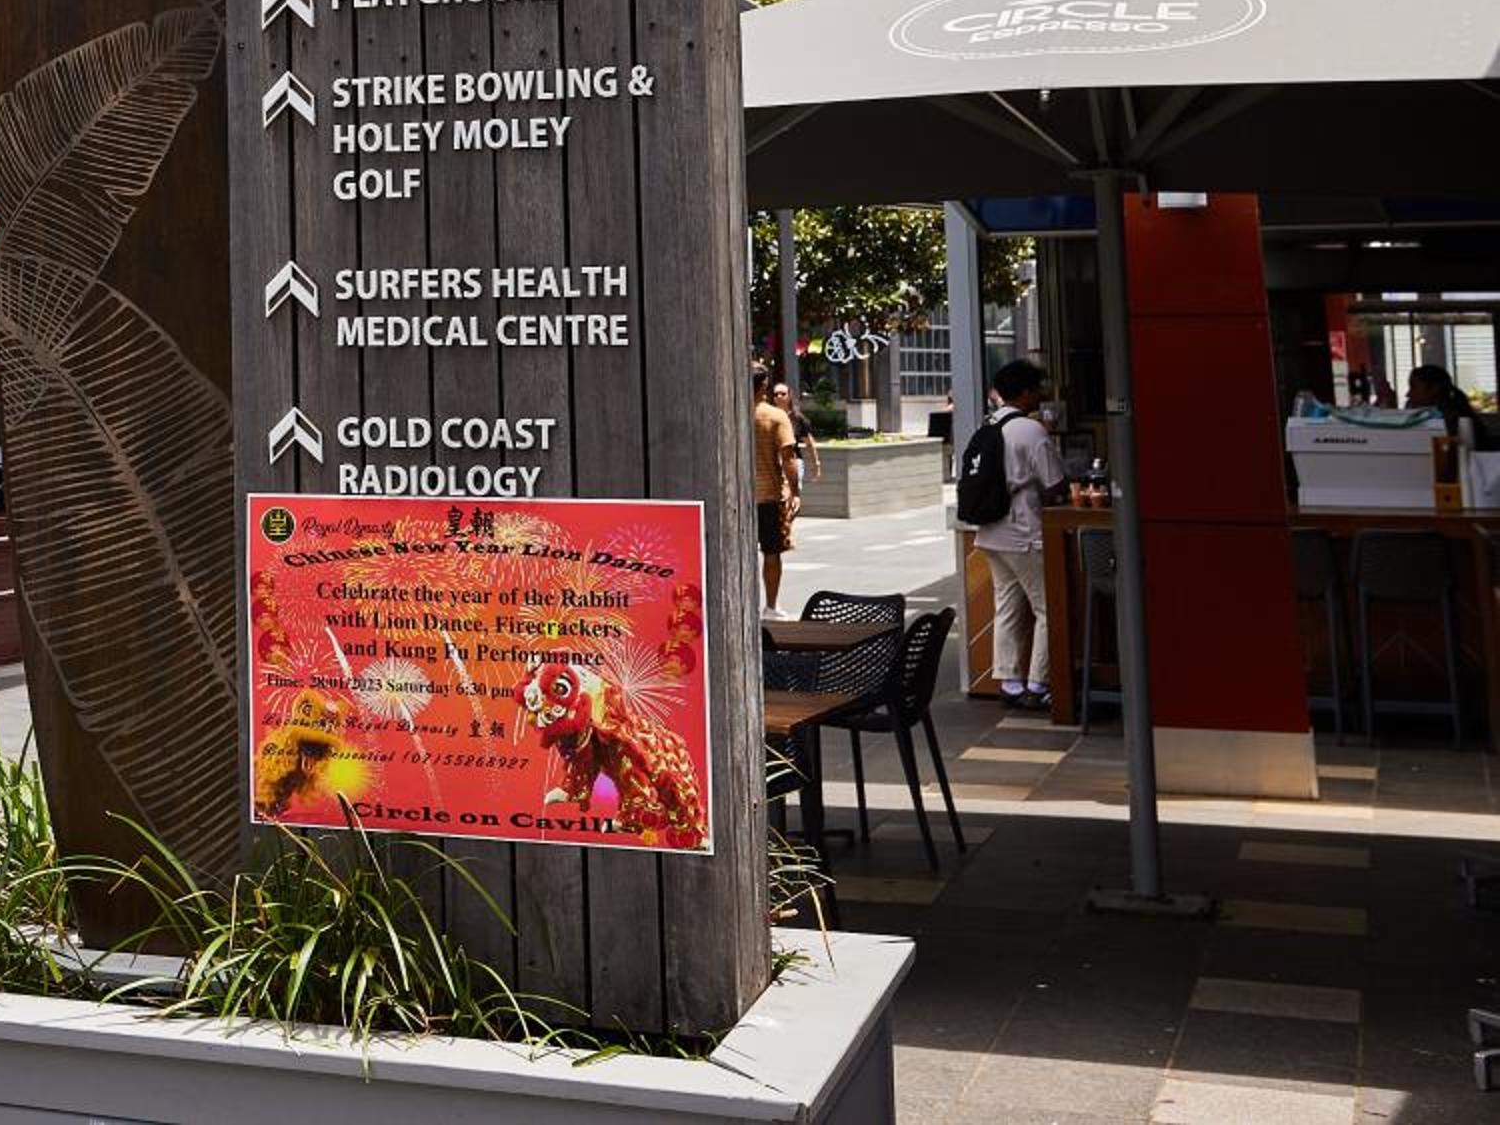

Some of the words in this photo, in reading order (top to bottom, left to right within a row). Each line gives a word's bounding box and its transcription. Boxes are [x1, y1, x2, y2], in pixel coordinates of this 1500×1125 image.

[943, 0, 1199, 32] CIRCLE
[332, 74, 446, 108] STRIKE
[454, 66, 618, 104] BOWLING
[628, 65, 654, 96] &
[333, 121, 444, 154] HOLEY
[452, 116, 572, 151] MOLEY
[333, 168, 421, 201] GOLF
[335, 268, 482, 301] SURFERS
[492, 266, 627, 299] HEALTH
[337, 316, 488, 347] MEDICAL
[496, 315, 629, 346] CENTRE
[337, 416, 431, 448] GOLD
[441, 418, 556, 450] COAST
[339, 464, 541, 497] RADIOLOGY
[283, 544, 387, 568] Chinese
[390, 539, 447, 554] New
[454, 540, 515, 555] Year
[521, 543, 582, 562] Lion
[588, 551, 674, 578] Dance
[317, 582, 409, 603] Celebrate
[414, 585, 443, 603] the
[450, 588, 491, 607] year
[499, 588, 518, 605] of
[524, 589, 555, 606] the
[561, 589, 630, 609] Rabbit
[325, 612, 370, 629] with
[373, 612, 416, 631] Lion
[422, 613, 488, 634] Dance,
[495, 616, 622, 638] Firecrackers
[342, 640, 383, 657] and
[385, 642, 437, 662] Kung
[444, 643, 469, 660] Fu
[477, 644, 605, 666] Performance
[385, 679, 450, 697] Saturday
[455, 681, 486, 697] 6:30
[490, 685, 515, 699] pm
[352, 802, 450, 824] Circle
[459, 811, 499, 826] on
